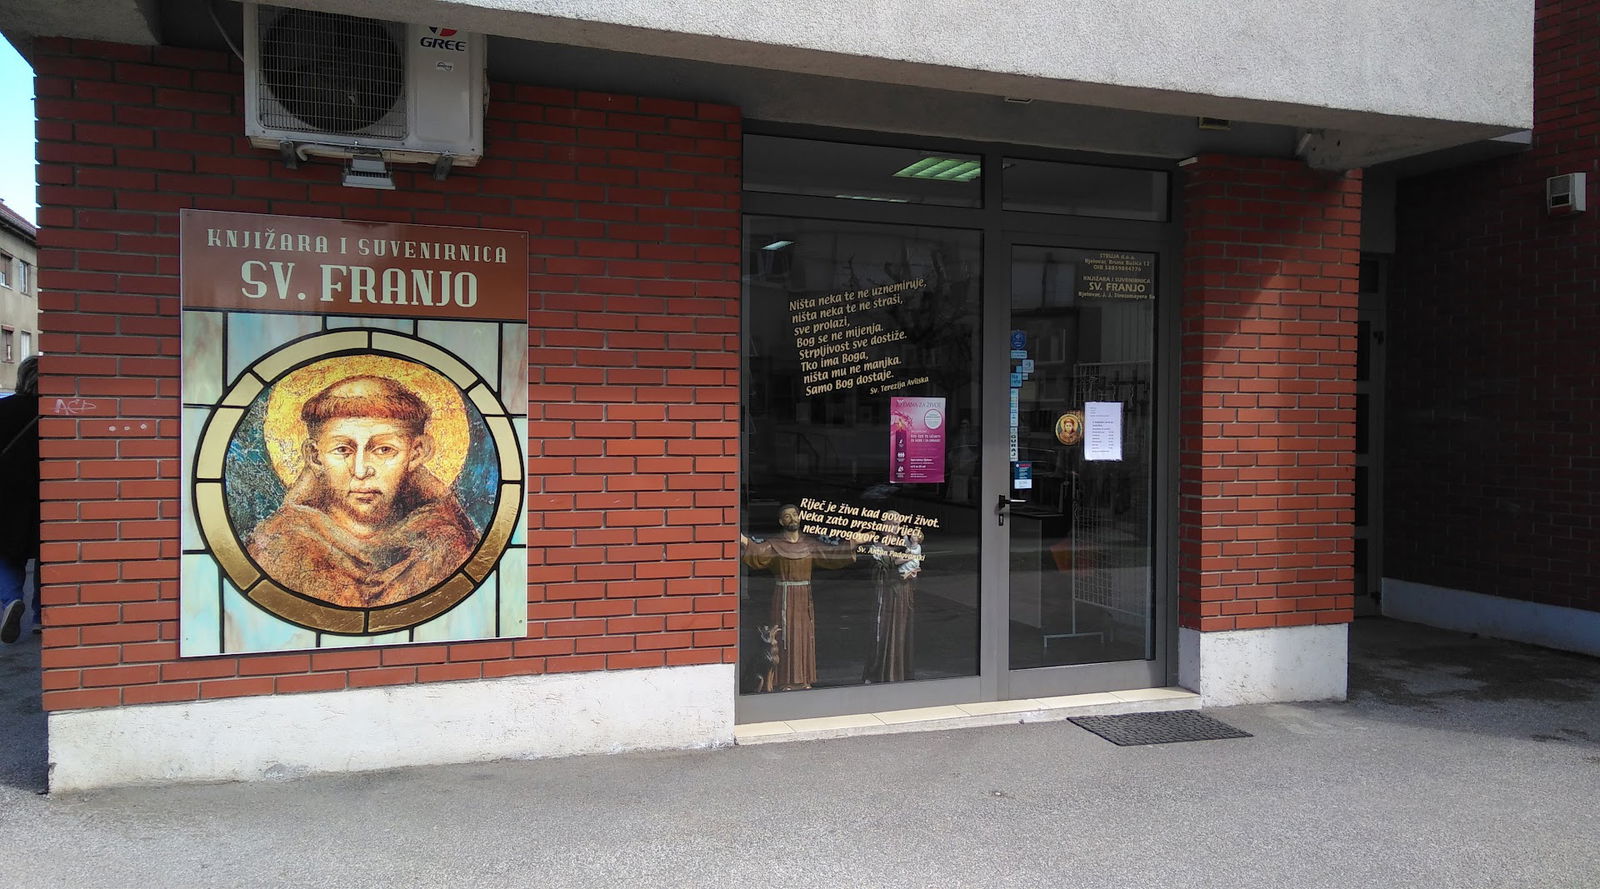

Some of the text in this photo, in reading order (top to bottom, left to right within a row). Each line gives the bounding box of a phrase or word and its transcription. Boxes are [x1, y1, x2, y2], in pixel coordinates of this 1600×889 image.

[420, 37, 467, 52] GREE
[207, 228, 507, 263] KNJIŽARA I SUVENIRNICA
[241, 260, 478, 308] SV. FRANJO
[789, 278, 927, 312] Ništa neka te ne uznemiruje,
[1089, 281, 1145, 293] SV. FRANJO
[792, 294, 904, 324] ništa neka te ne straši,
[793, 316, 850, 336] sve prolazi,
[796, 322, 884, 348] Bog se ne mijenja.
[800, 331, 907, 360] Strpljivost sve dostiže.
[801, 351, 869, 372] Tko ima Boga,
[803, 356, 902, 384] ništa mu ne manjka.
[805, 370, 894, 396] Samo Bog dostaje.
[870, 386, 879, 395] Sv.
[881, 381, 906, 393] Terezija
[798, 510, 922, 539] Neka zato prestanu riječi,
[800, 498, 940, 528] Riječ je živa kad govori život.
[803, 524, 907, 546] neka progovore djela.
[857, 546, 866, 554] Sv.
